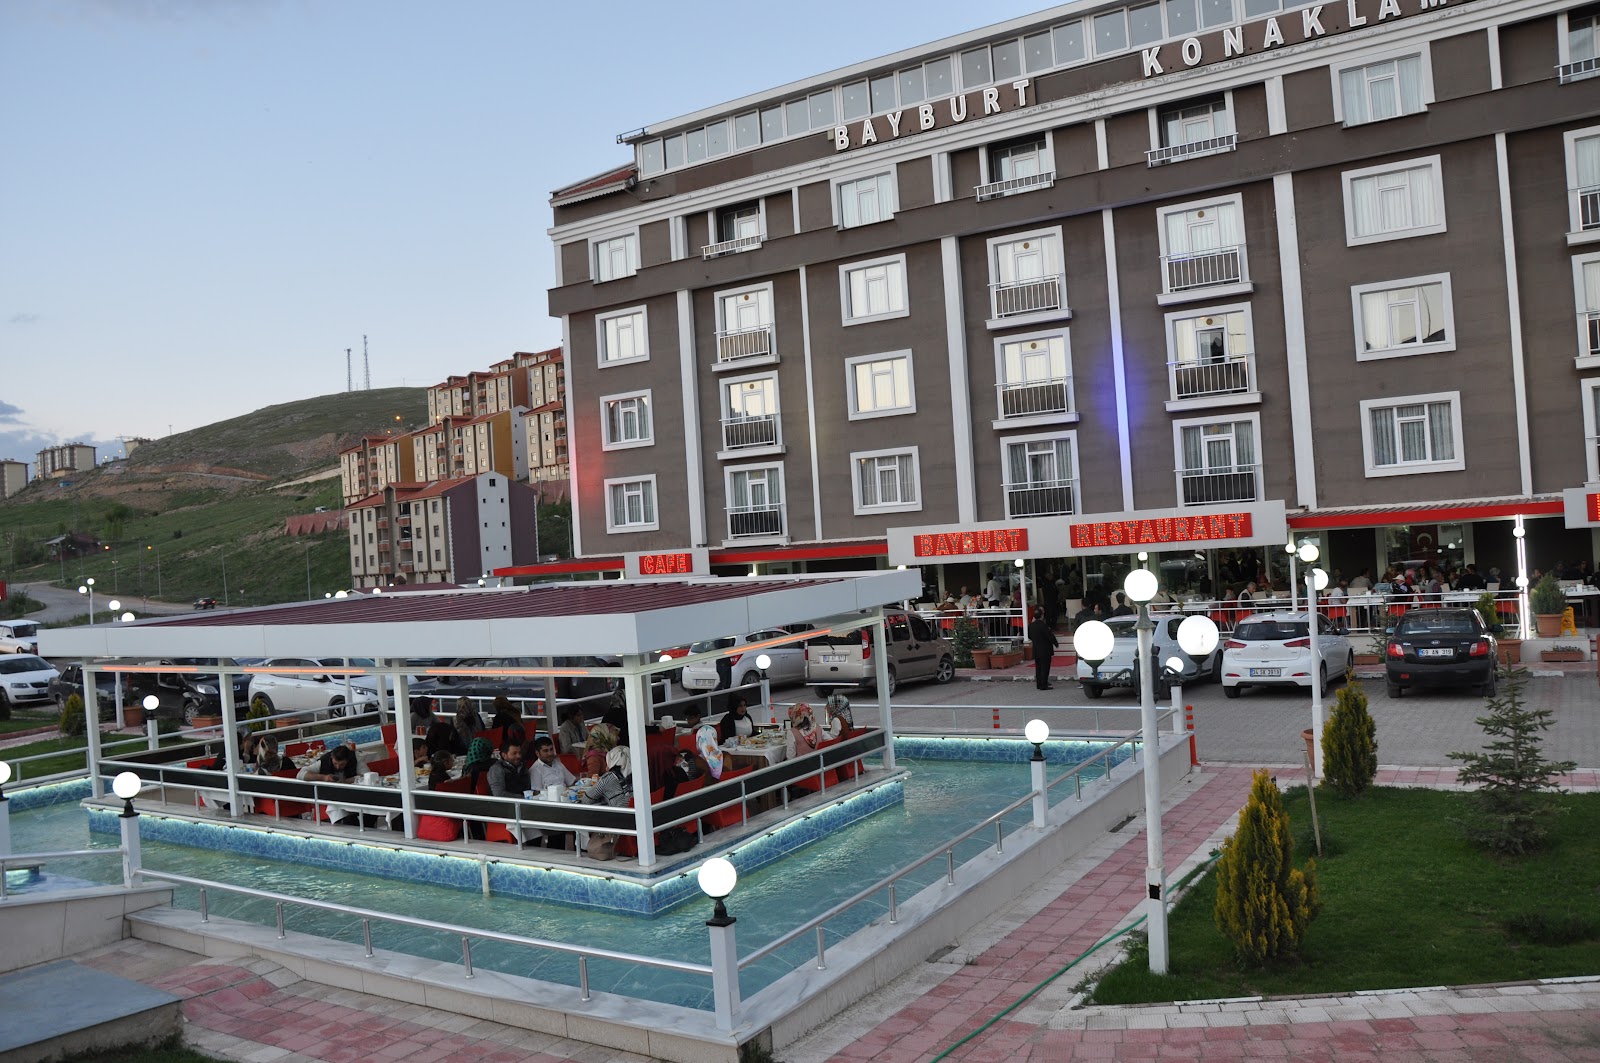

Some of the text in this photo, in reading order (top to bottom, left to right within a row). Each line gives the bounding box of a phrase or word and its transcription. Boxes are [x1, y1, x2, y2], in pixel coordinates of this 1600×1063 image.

[834, 80, 1030, 150] BAYBURT
[920, 514, 1246, 556] BAYBURT RESTAURANT
[643, 553, 687, 573] CAFE
